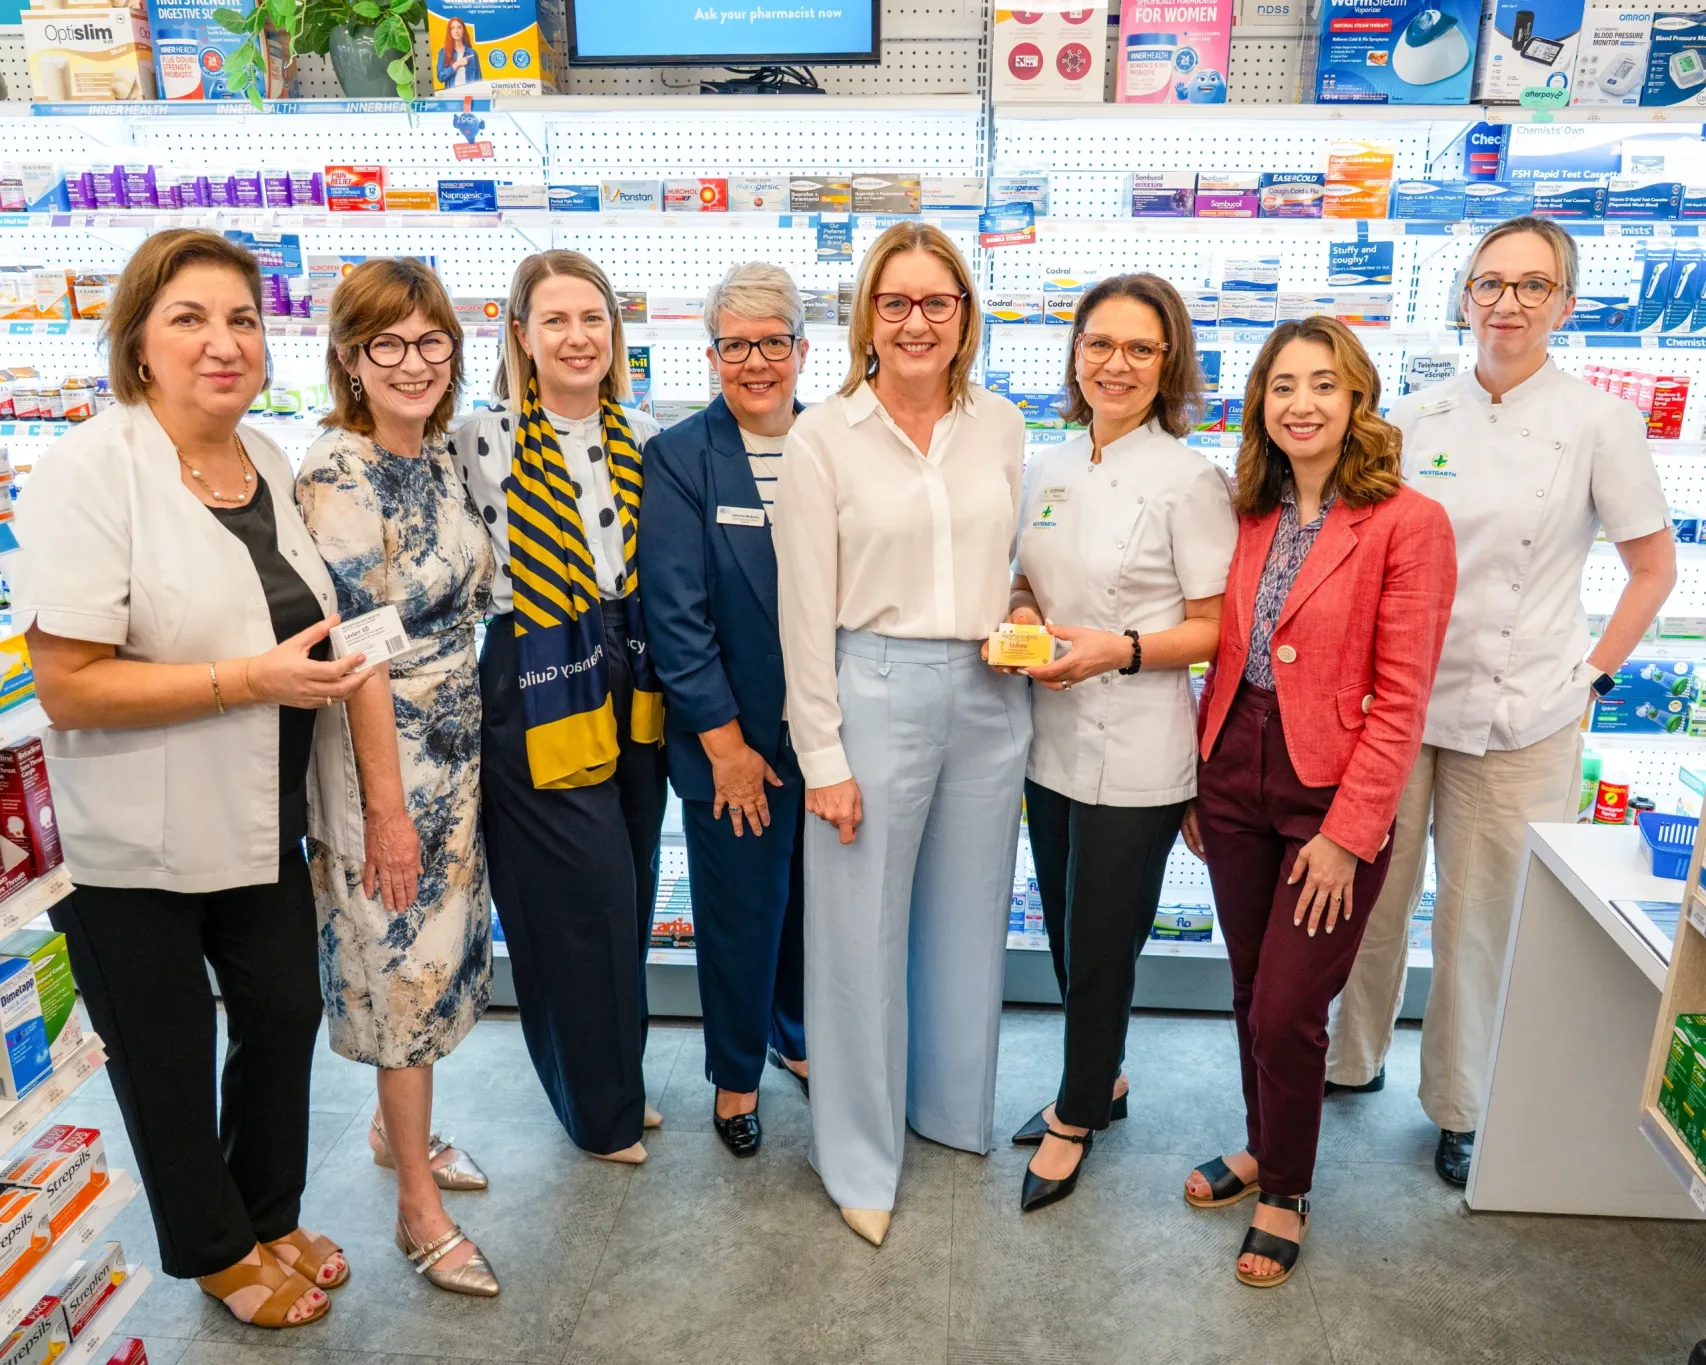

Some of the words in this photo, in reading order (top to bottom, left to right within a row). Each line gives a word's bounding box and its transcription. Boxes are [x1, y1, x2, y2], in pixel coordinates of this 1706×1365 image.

[158, 8, 201, 19] DIGESTIVE
[694, 8, 717, 20] Ask
[720, 10, 747, 24] your
[750, 8, 815, 24] pharmacist
[818, 9, 842, 19] now
[1135, 8, 1162, 23] FOR
[1164, 6, 1218, 22] WOMEN
[44, 24, 114, 44] Optislim
[1131, 51, 1169, 59] INNERHEALTH
[1524, 90, 1556, 99] afterpay
[88, 104, 169, 115] INNERHEALTH
[1516, 126, 1563, 136] Chemists'
[1564, 126, 1585, 135] Own
[1511, 169, 1531, 179] FSH
[1532, 169, 1559, 181] Rapid
[1561, 170, 1582, 179] Test
[735, 183, 780, 191] maxigesic
[441, 190, 482, 200] Naprogesic
[619, 192, 654, 202] Ponstan
[1332, 245, 1359, 256] Stuffy
[1360, 245, 1377, 253] and
[1332, 255, 1369, 265] coughy?
[1045, 267, 1071, 275] Codral
[987, 299, 1013, 307] Codral
[1047, 300, 1073, 308] Codral
[1244, 332, 1265, 341] Own
[1042, 433, 1062, 442] Own
[1419, 470, 1457, 478] WESTGARTH
[1011, 897, 1024, 907] flo
[1175, 917, 1192, 928] flo
[61, 1129, 86, 1152] VALUE
[73, 1131, 91, 1151] PACK
[46, 1148, 91, 1198] Strepsils
[0, 1209, 33, 1248] epsils
[70, 1264, 110, 1314] Strepfen
